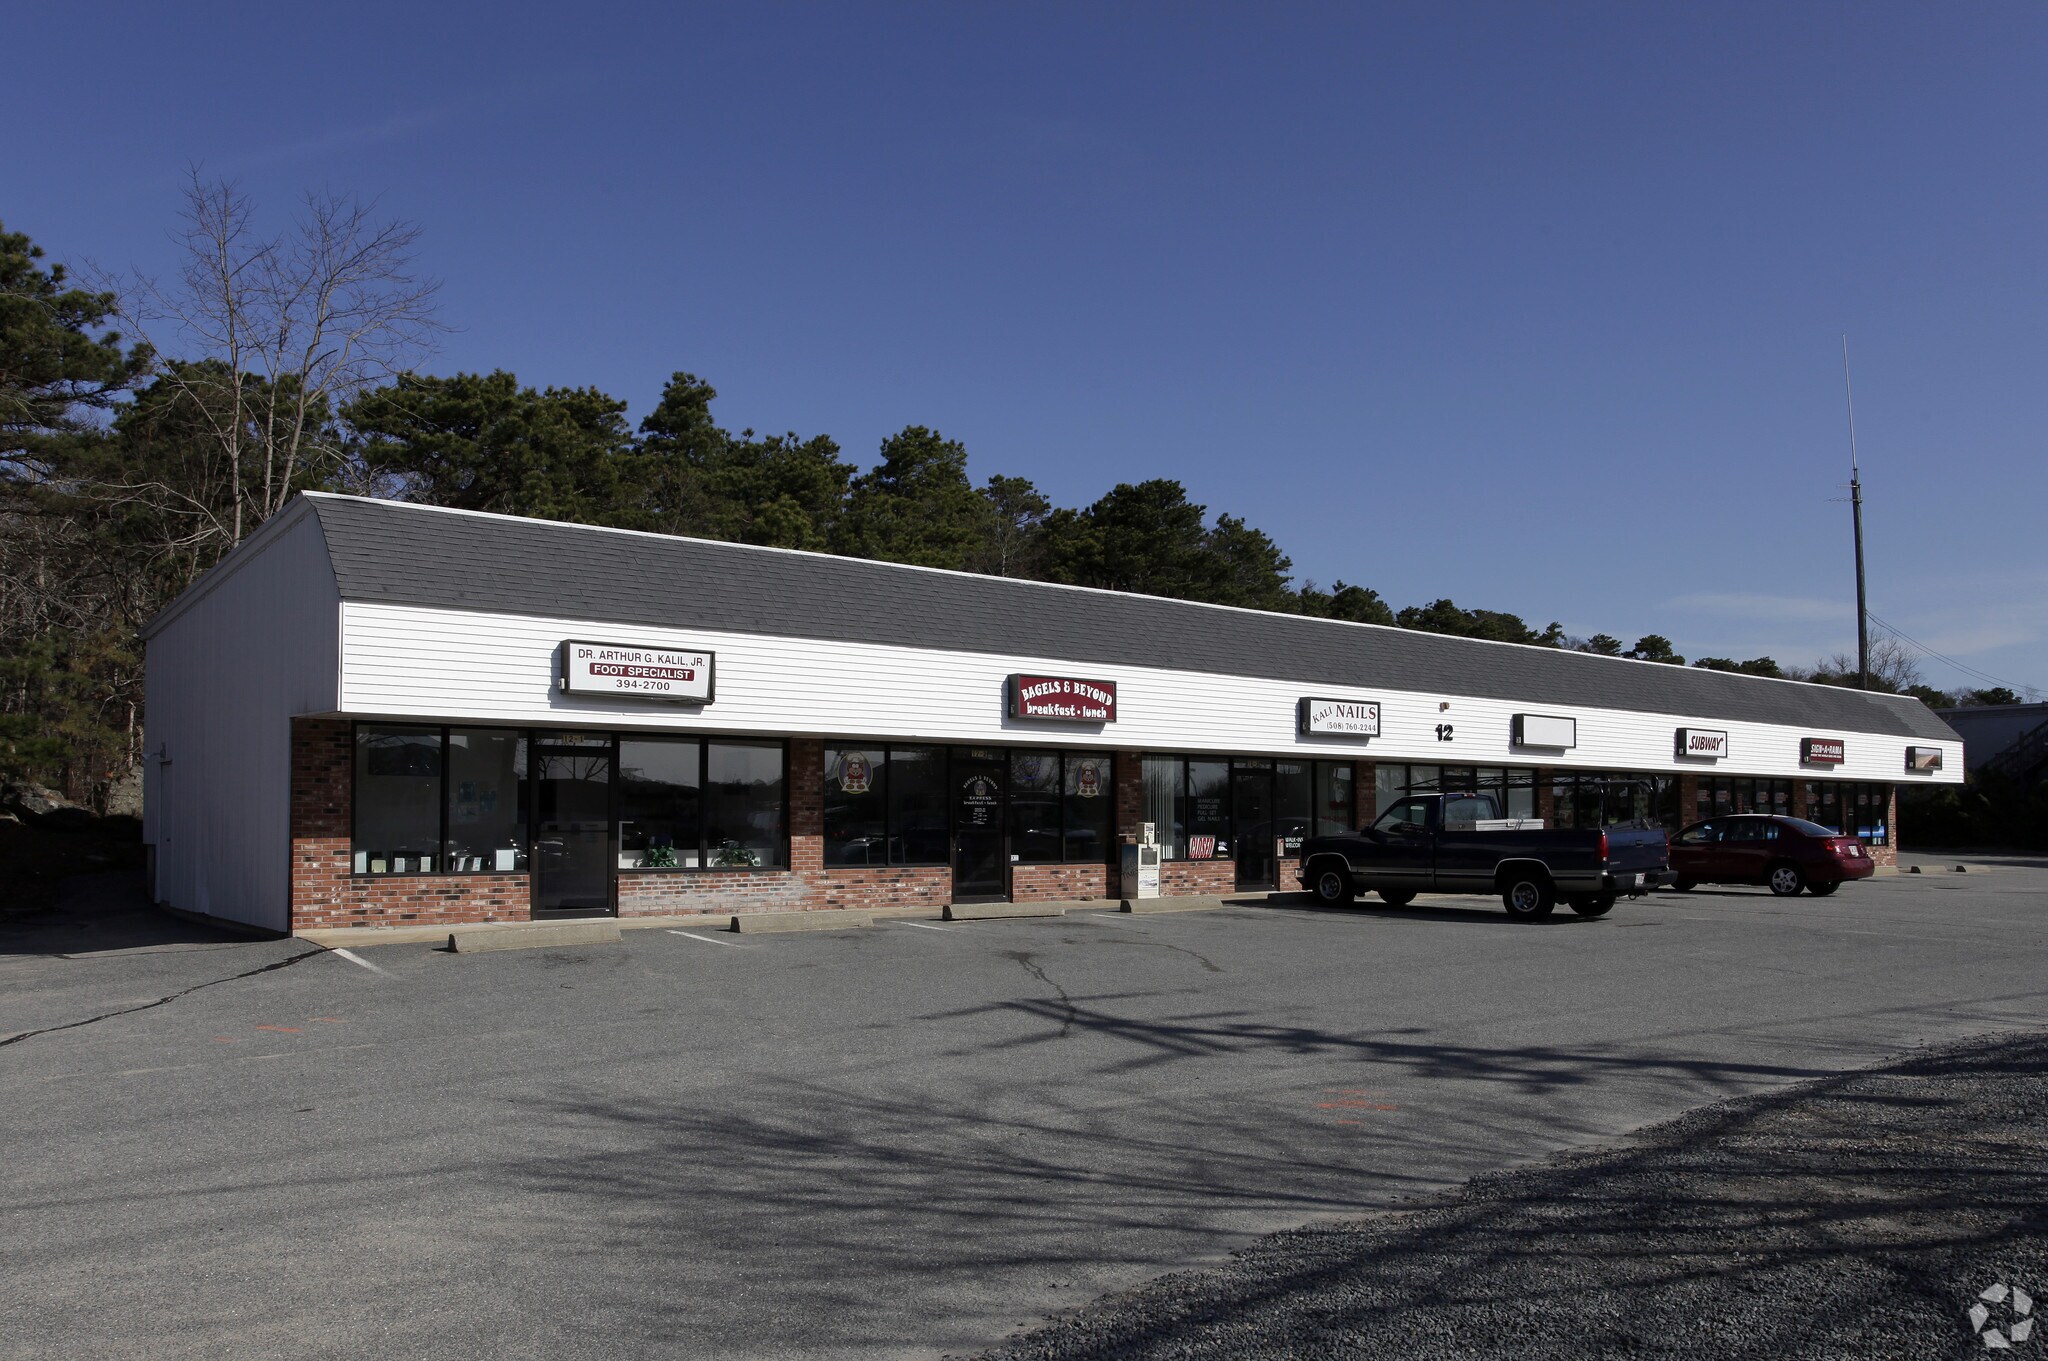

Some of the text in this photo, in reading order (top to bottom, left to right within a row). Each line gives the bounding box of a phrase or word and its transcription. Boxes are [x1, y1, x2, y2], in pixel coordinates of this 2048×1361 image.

[578, 649, 706, 667] DR. ARTHUR G. KALIL, JR.
[594, 664, 690, 680] FOOT SPECIALIST
[616, 679, 670, 691] 394-2700
[1021, 681, 1113, 706] BAGELS & BEYOND
[1026, 702, 1107, 719] breakfast lunch
[1312, 704, 1377, 724] KALI NAILS
[1326, 721, 1377, 732] (508) 760-2244
[1435, 723, 1454, 742] 12
[1689, 736, 1724, 751] SUBWAY
[1189, 837, 1214, 858] CLOSED
